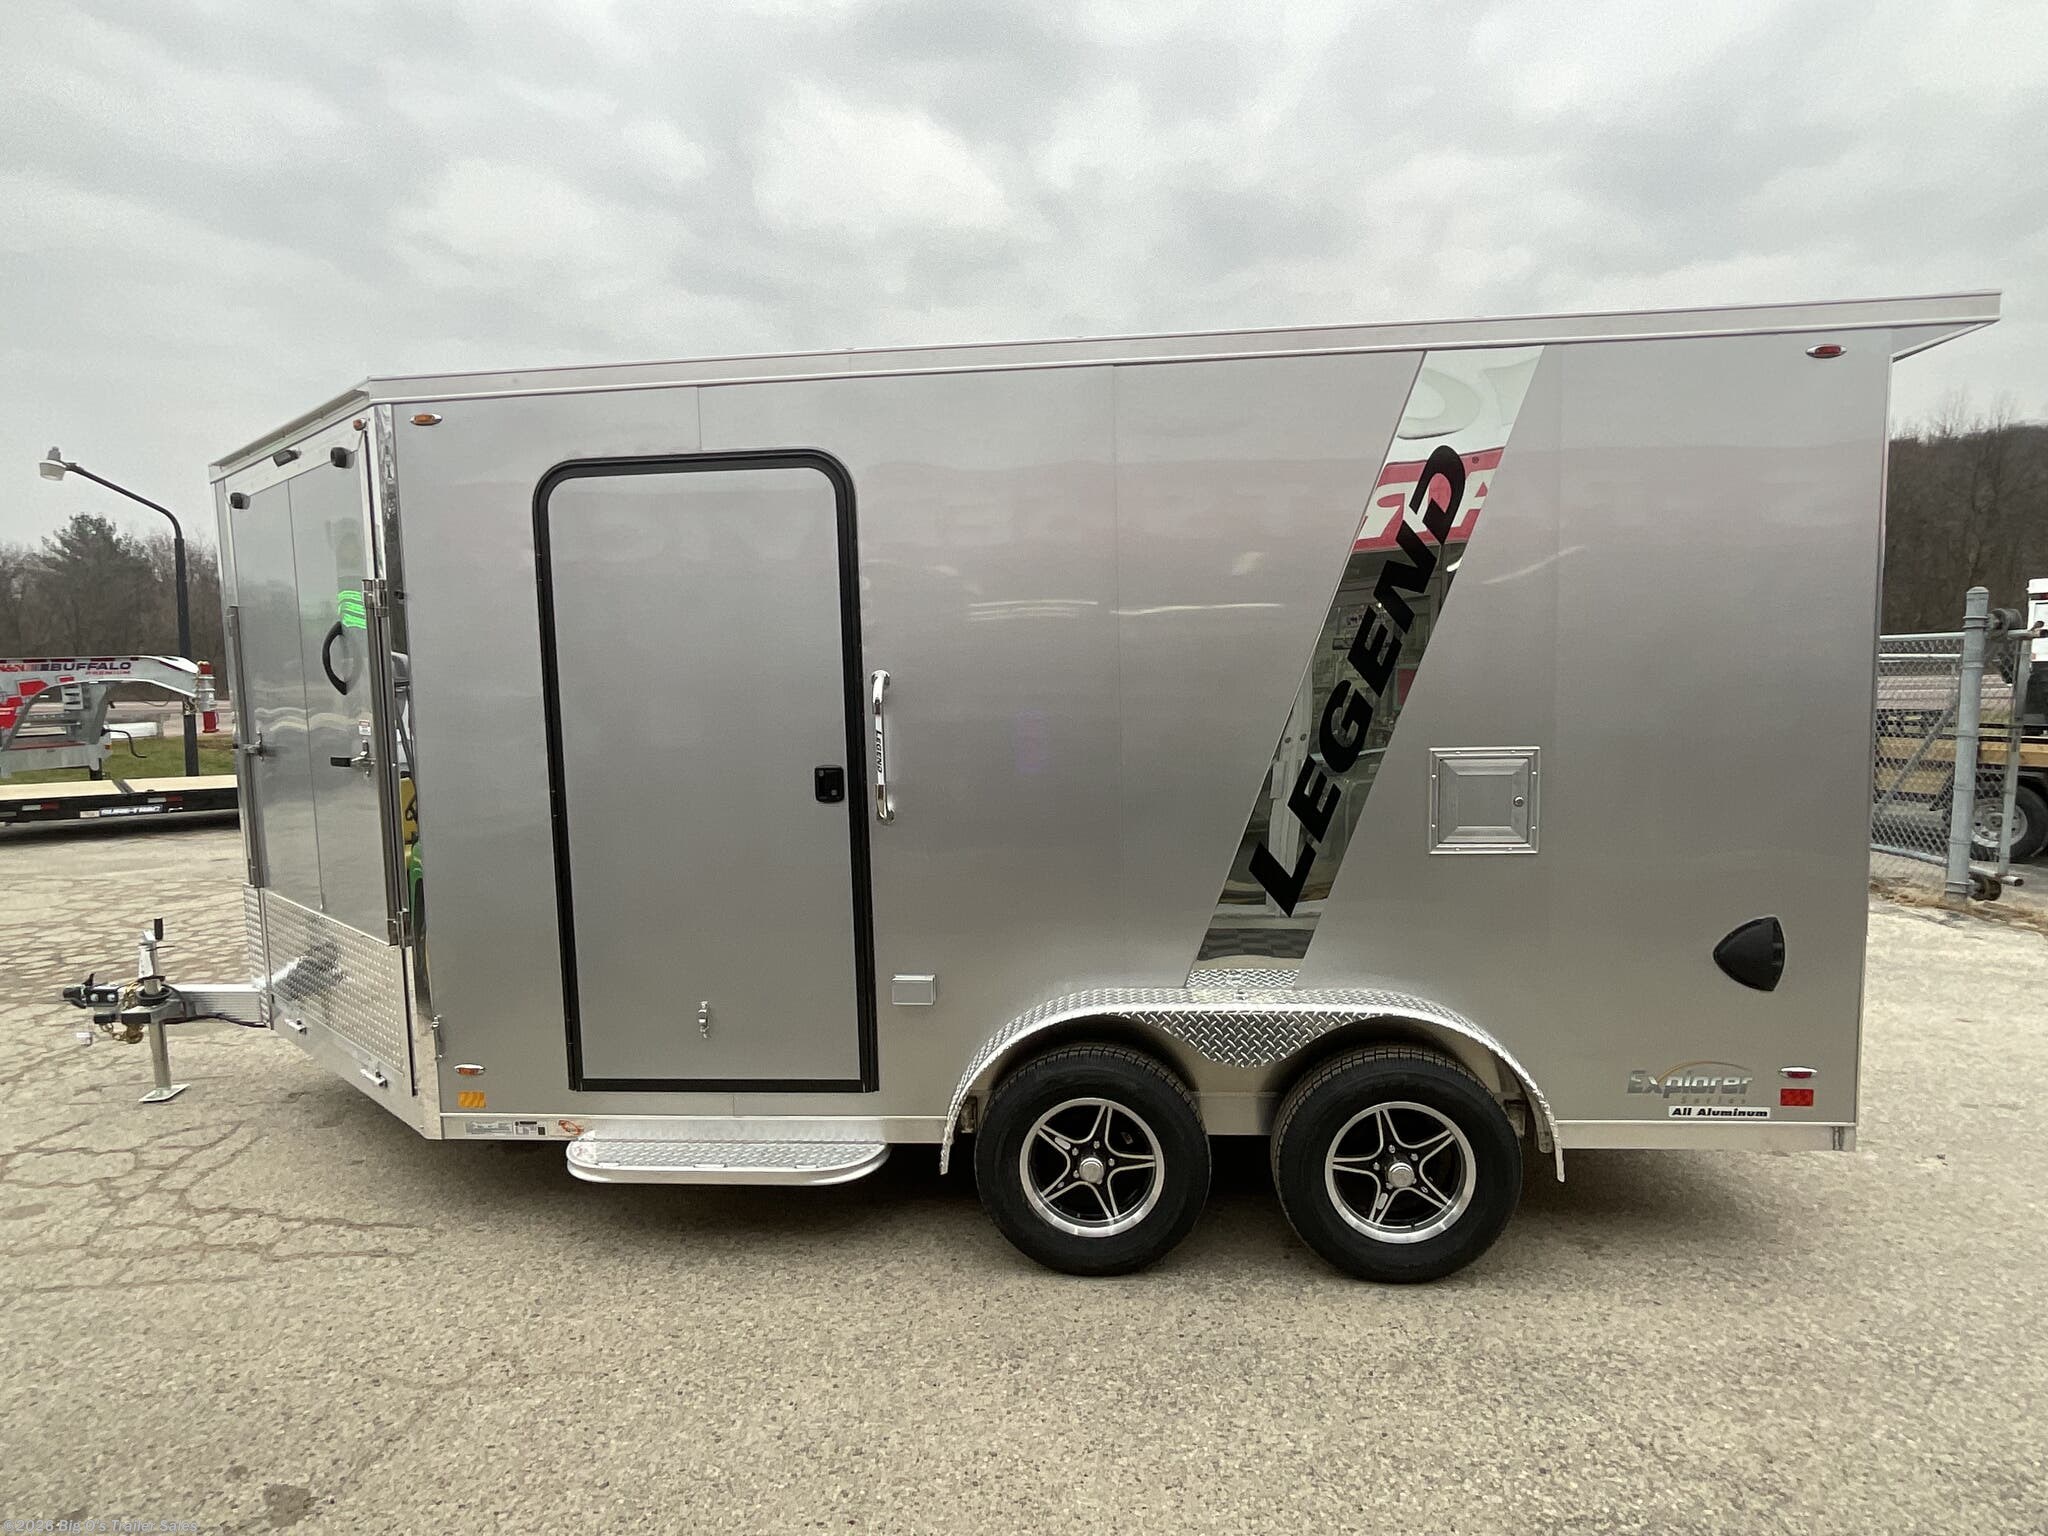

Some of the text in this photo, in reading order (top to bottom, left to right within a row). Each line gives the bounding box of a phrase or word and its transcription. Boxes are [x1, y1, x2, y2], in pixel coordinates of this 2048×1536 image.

[50, 661, 132, 672] BUFFALO
[1249, 444, 1467, 918] LEGEND
[875, 729, 883, 773] LEGEND
[1627, 1069, 1752, 1098] Explorer
[1671, 1107, 1768, 1117] All Aluminum
